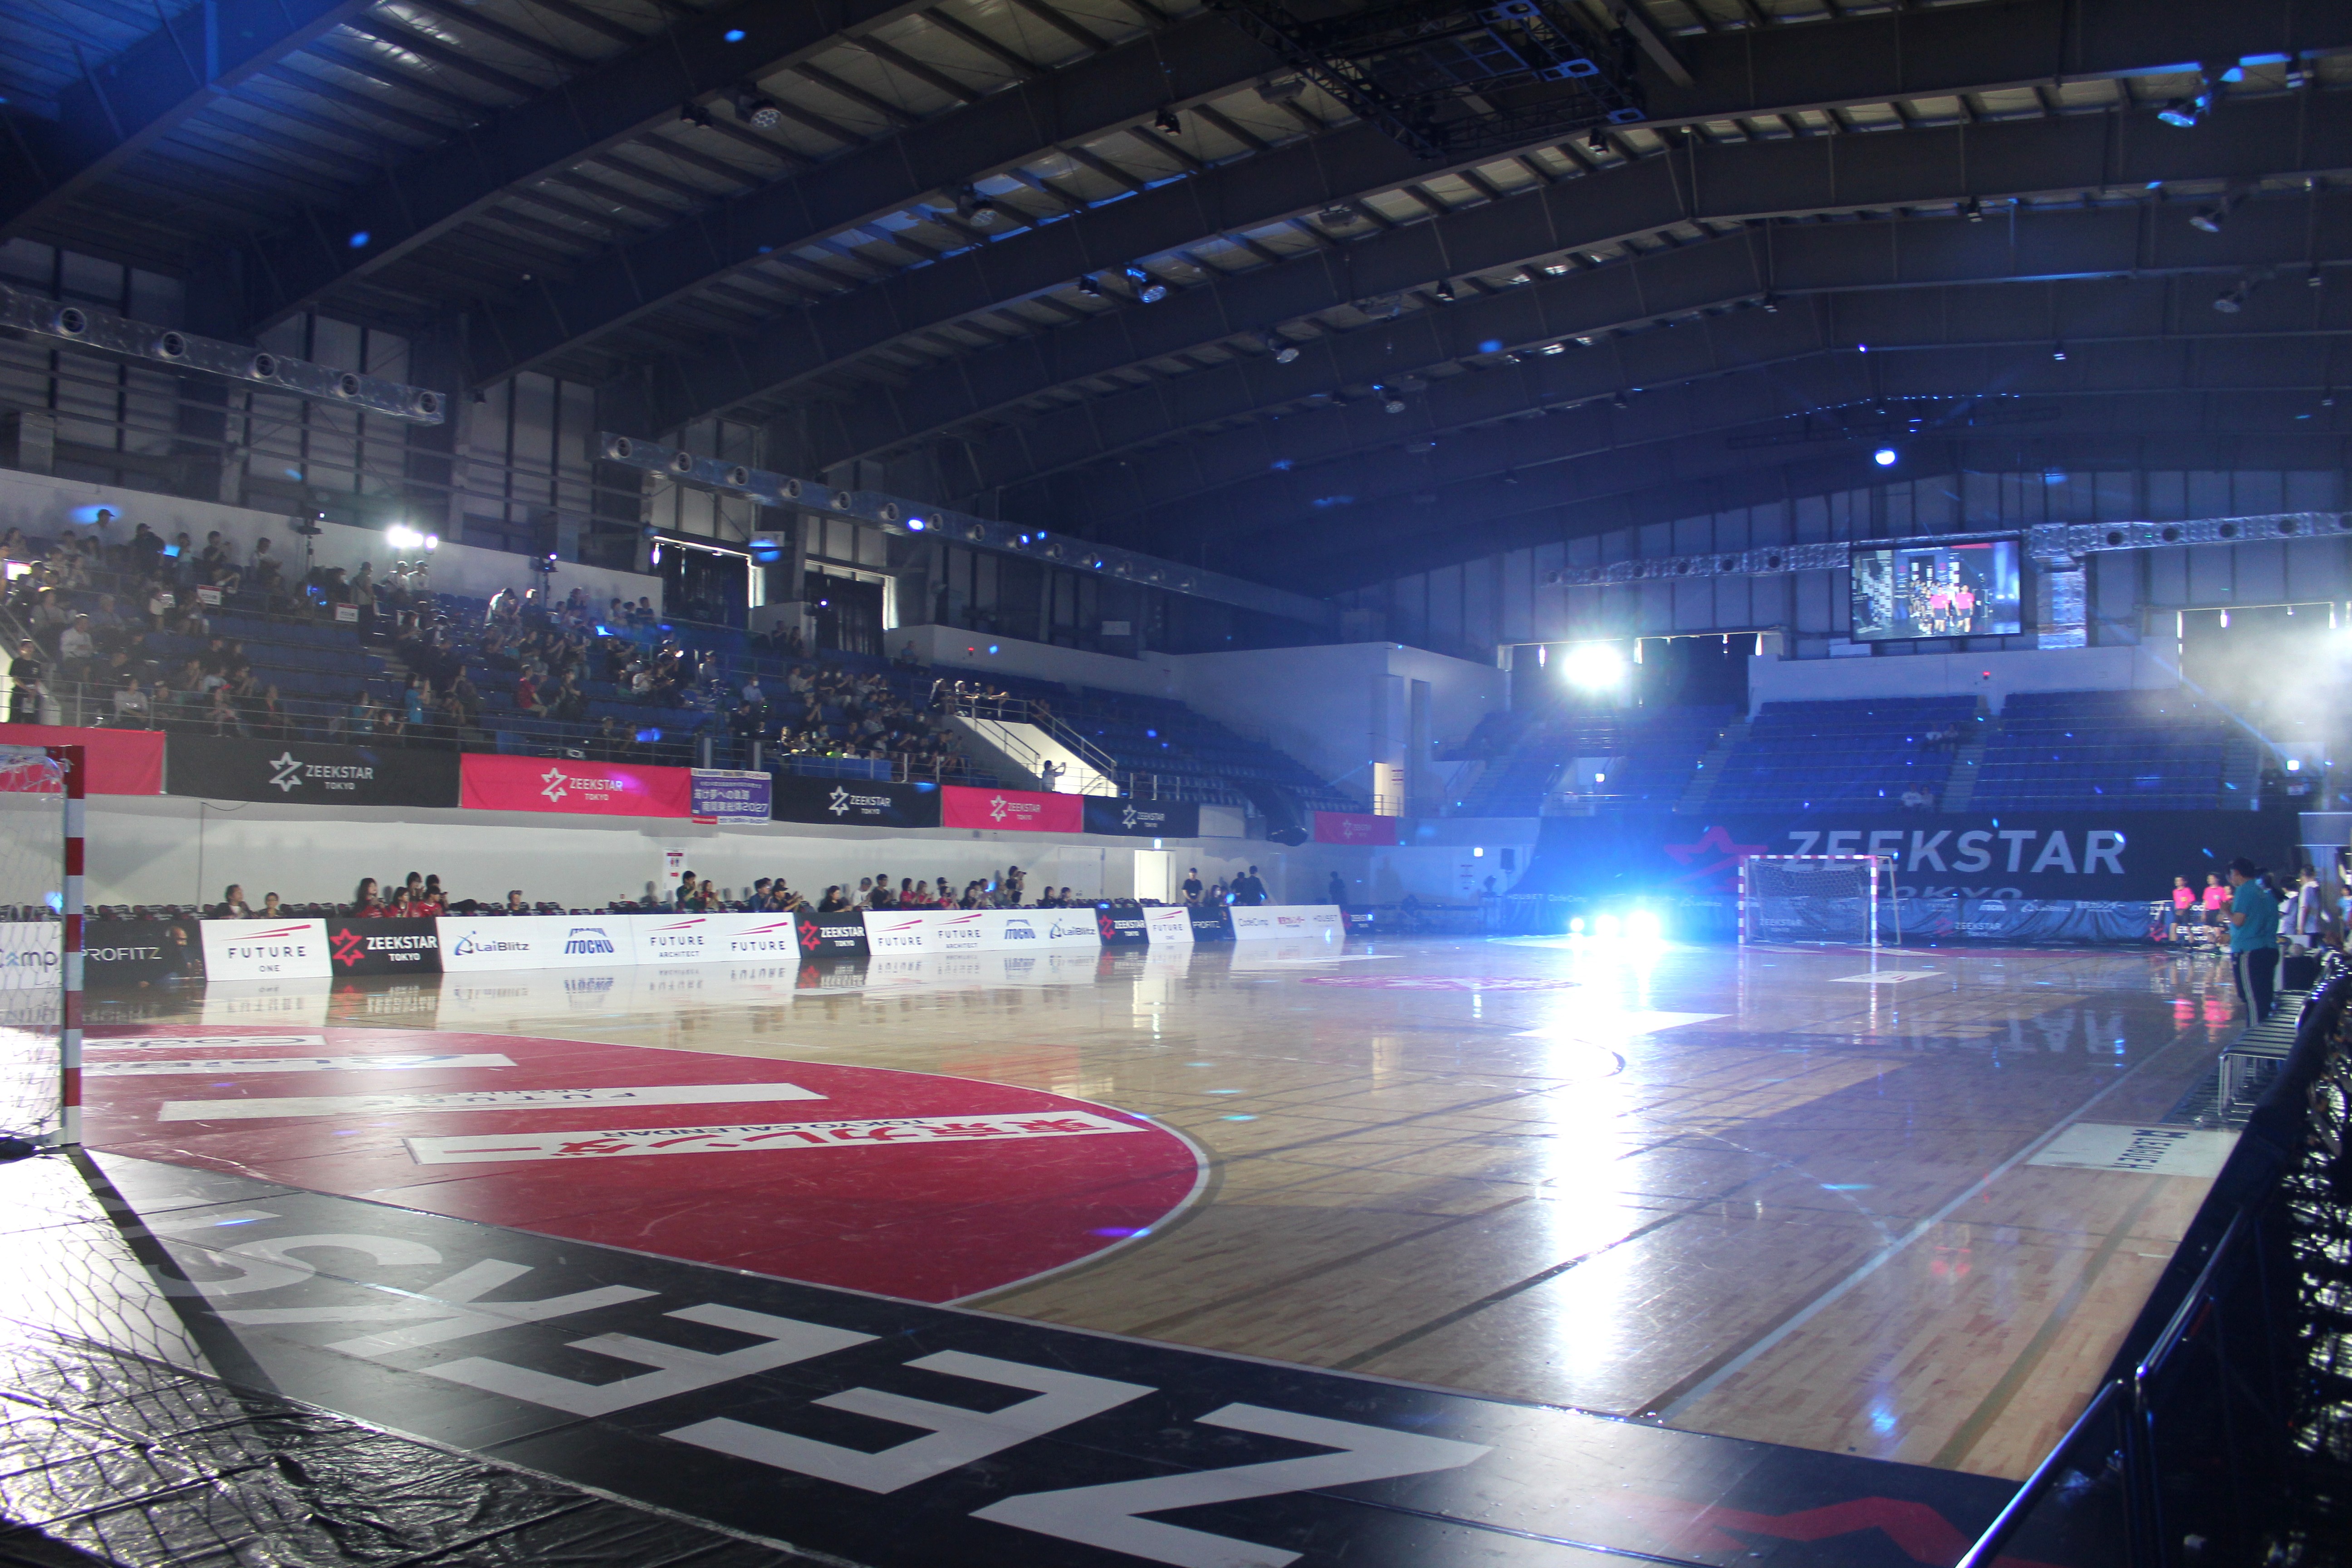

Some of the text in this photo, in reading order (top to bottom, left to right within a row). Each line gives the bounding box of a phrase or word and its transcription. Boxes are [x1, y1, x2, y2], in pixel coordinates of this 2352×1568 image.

[305, 764, 373, 779] ZEEKSTAR
[324, 781, 355, 789] TOKYO
[570, 777, 623, 792] ZEEKSTAR
[584, 793, 609, 801] TOKYO
[850, 795, 891, 808] ZEEKSTAR
[1007, 802, 1041, 813] ZEEKSTAR
[1783, 830, 2127, 874] ZEEKSTAR
[1113, 920, 1146, 929] ZEEKSTAR
[819, 926, 864, 938] ZEEKSTAR
[938, 929, 982, 939] FUTURE
[1063, 926, 1096, 936] LaiBlitz
[366, 935, 438, 950] ZEEKSTAR
[475, 940, 530, 952] LaiBlitz
[650, 935, 705, 946] FUTURE
[731, 941, 786, 952] FUTURE
[878, 936, 922, 946] FUTURE
[228, 946, 307, 958] FUTURE
[564, 939, 615, 955] ITOCHU
[388, 953, 421, 961] TOKYO
[259, 965, 280, 973] ONE
[364, 1093, 637, 1105] FUTURE
[600, 1120, 934, 1137] TOKYO CALENDAR
[442, 1118, 1111, 1156] 東京カレンダー
[2117, 1137, 2175, 1163] LEAGUE
